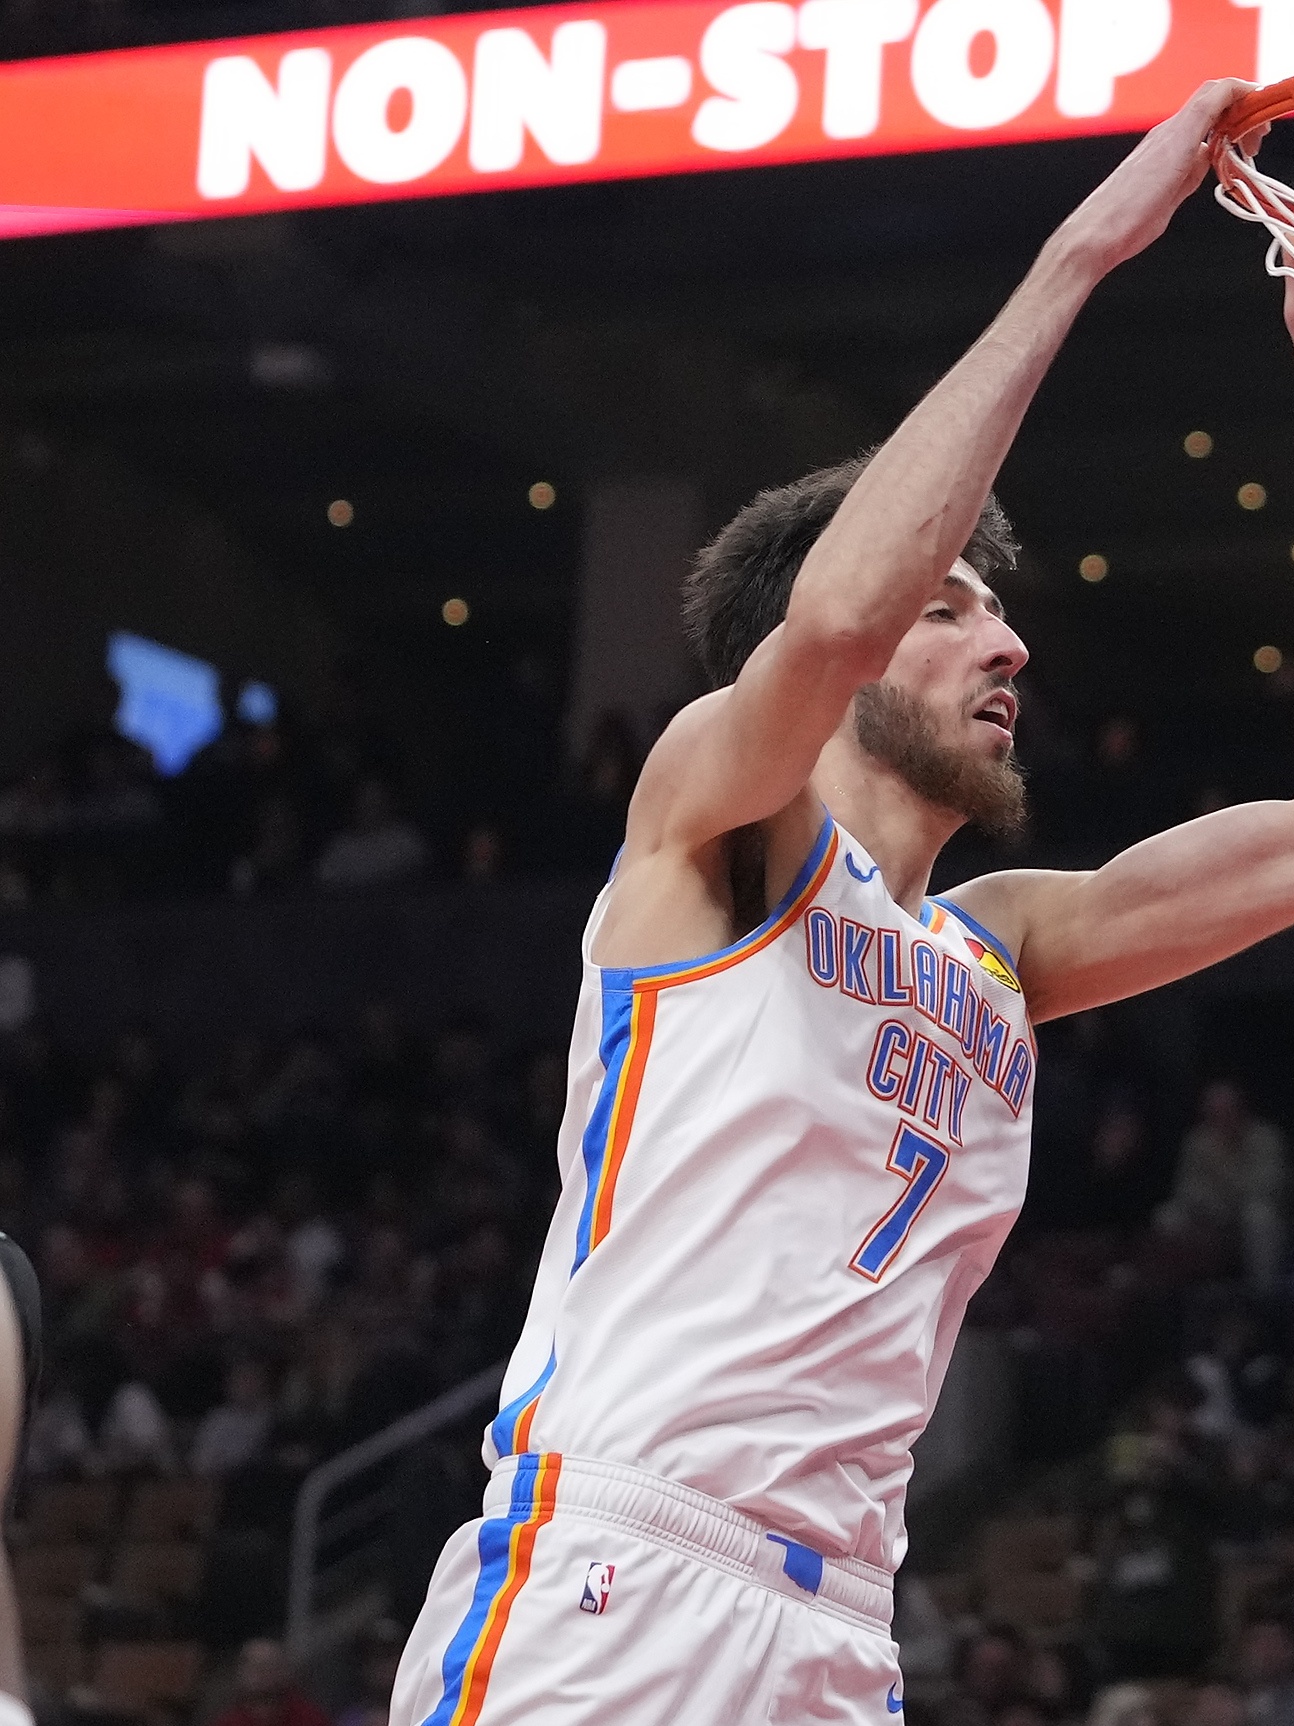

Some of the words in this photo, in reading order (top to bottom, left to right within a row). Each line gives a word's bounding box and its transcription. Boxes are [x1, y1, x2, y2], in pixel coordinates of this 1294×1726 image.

[197, 0, 1171, 200] NON-STOP
[867, 1019, 972, 1147] CITY
[848, 1118, 950, 1283] 7
